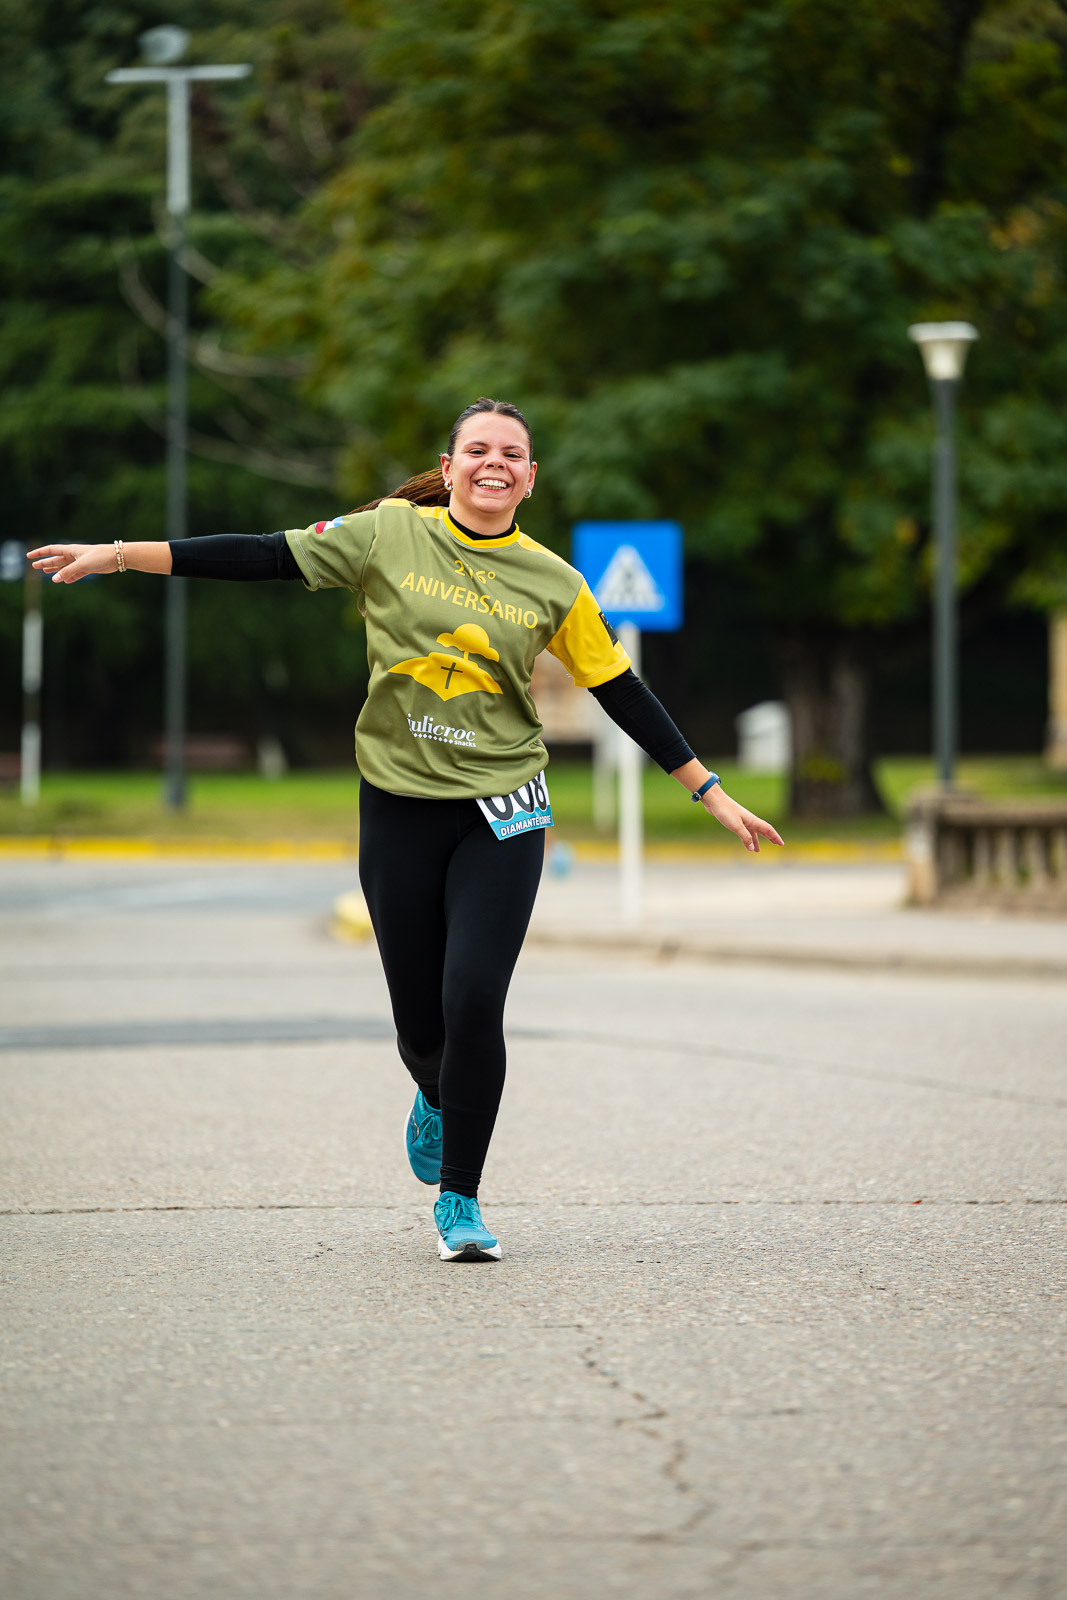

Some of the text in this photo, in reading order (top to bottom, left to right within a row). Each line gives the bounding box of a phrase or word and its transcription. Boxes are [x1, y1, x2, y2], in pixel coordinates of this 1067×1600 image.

[399, 571, 539, 629] ANIVERSARIO
[454, 739, 477, 748] snacks
[500, 816, 540, 837] DIAMANTE
